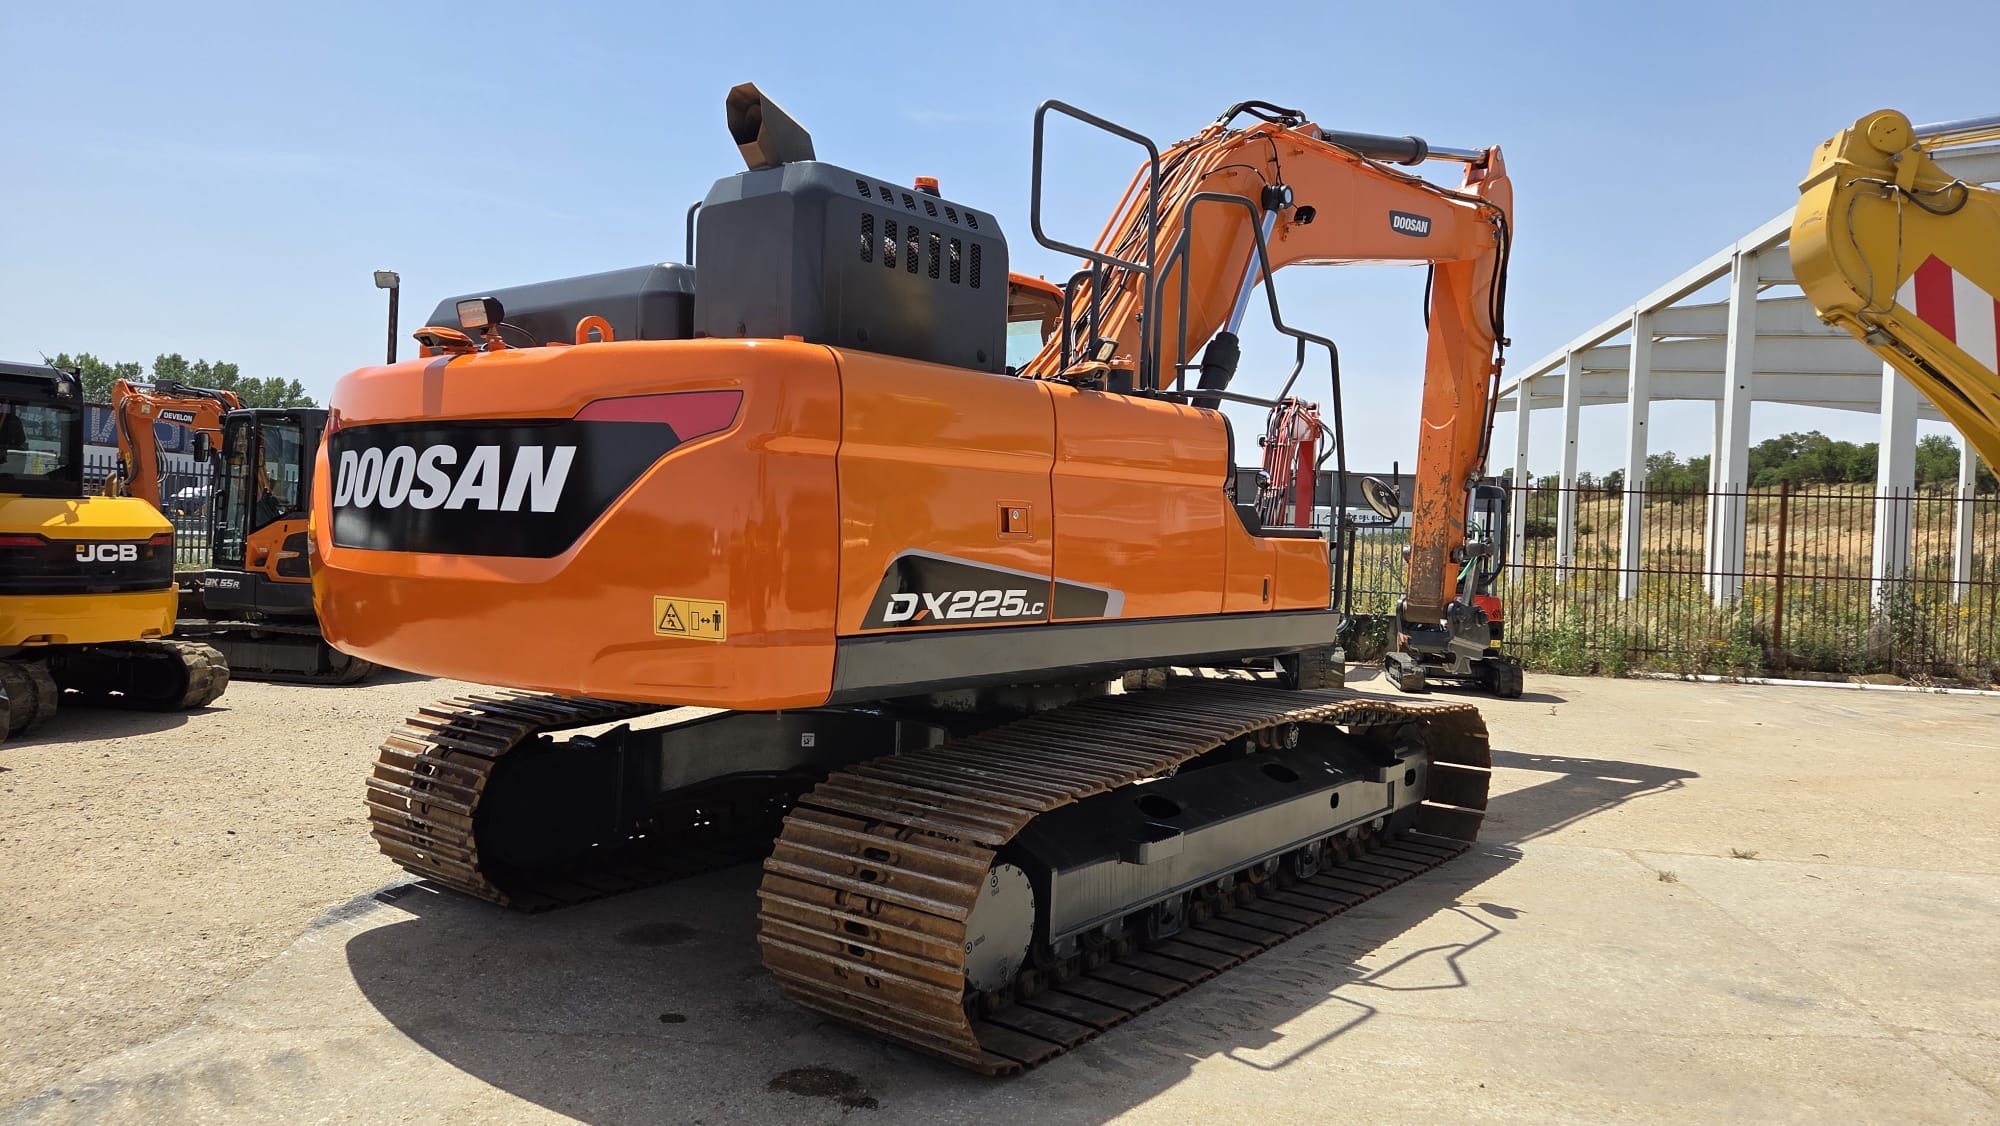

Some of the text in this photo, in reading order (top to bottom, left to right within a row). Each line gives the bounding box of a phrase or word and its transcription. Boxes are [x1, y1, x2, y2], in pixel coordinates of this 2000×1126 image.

[1393, 215, 1429, 233] DOOSAN
[163, 411, 193, 423] DEVELON
[334, 445, 577, 513] DOOSAN
[76, 544, 138, 562] JCB
